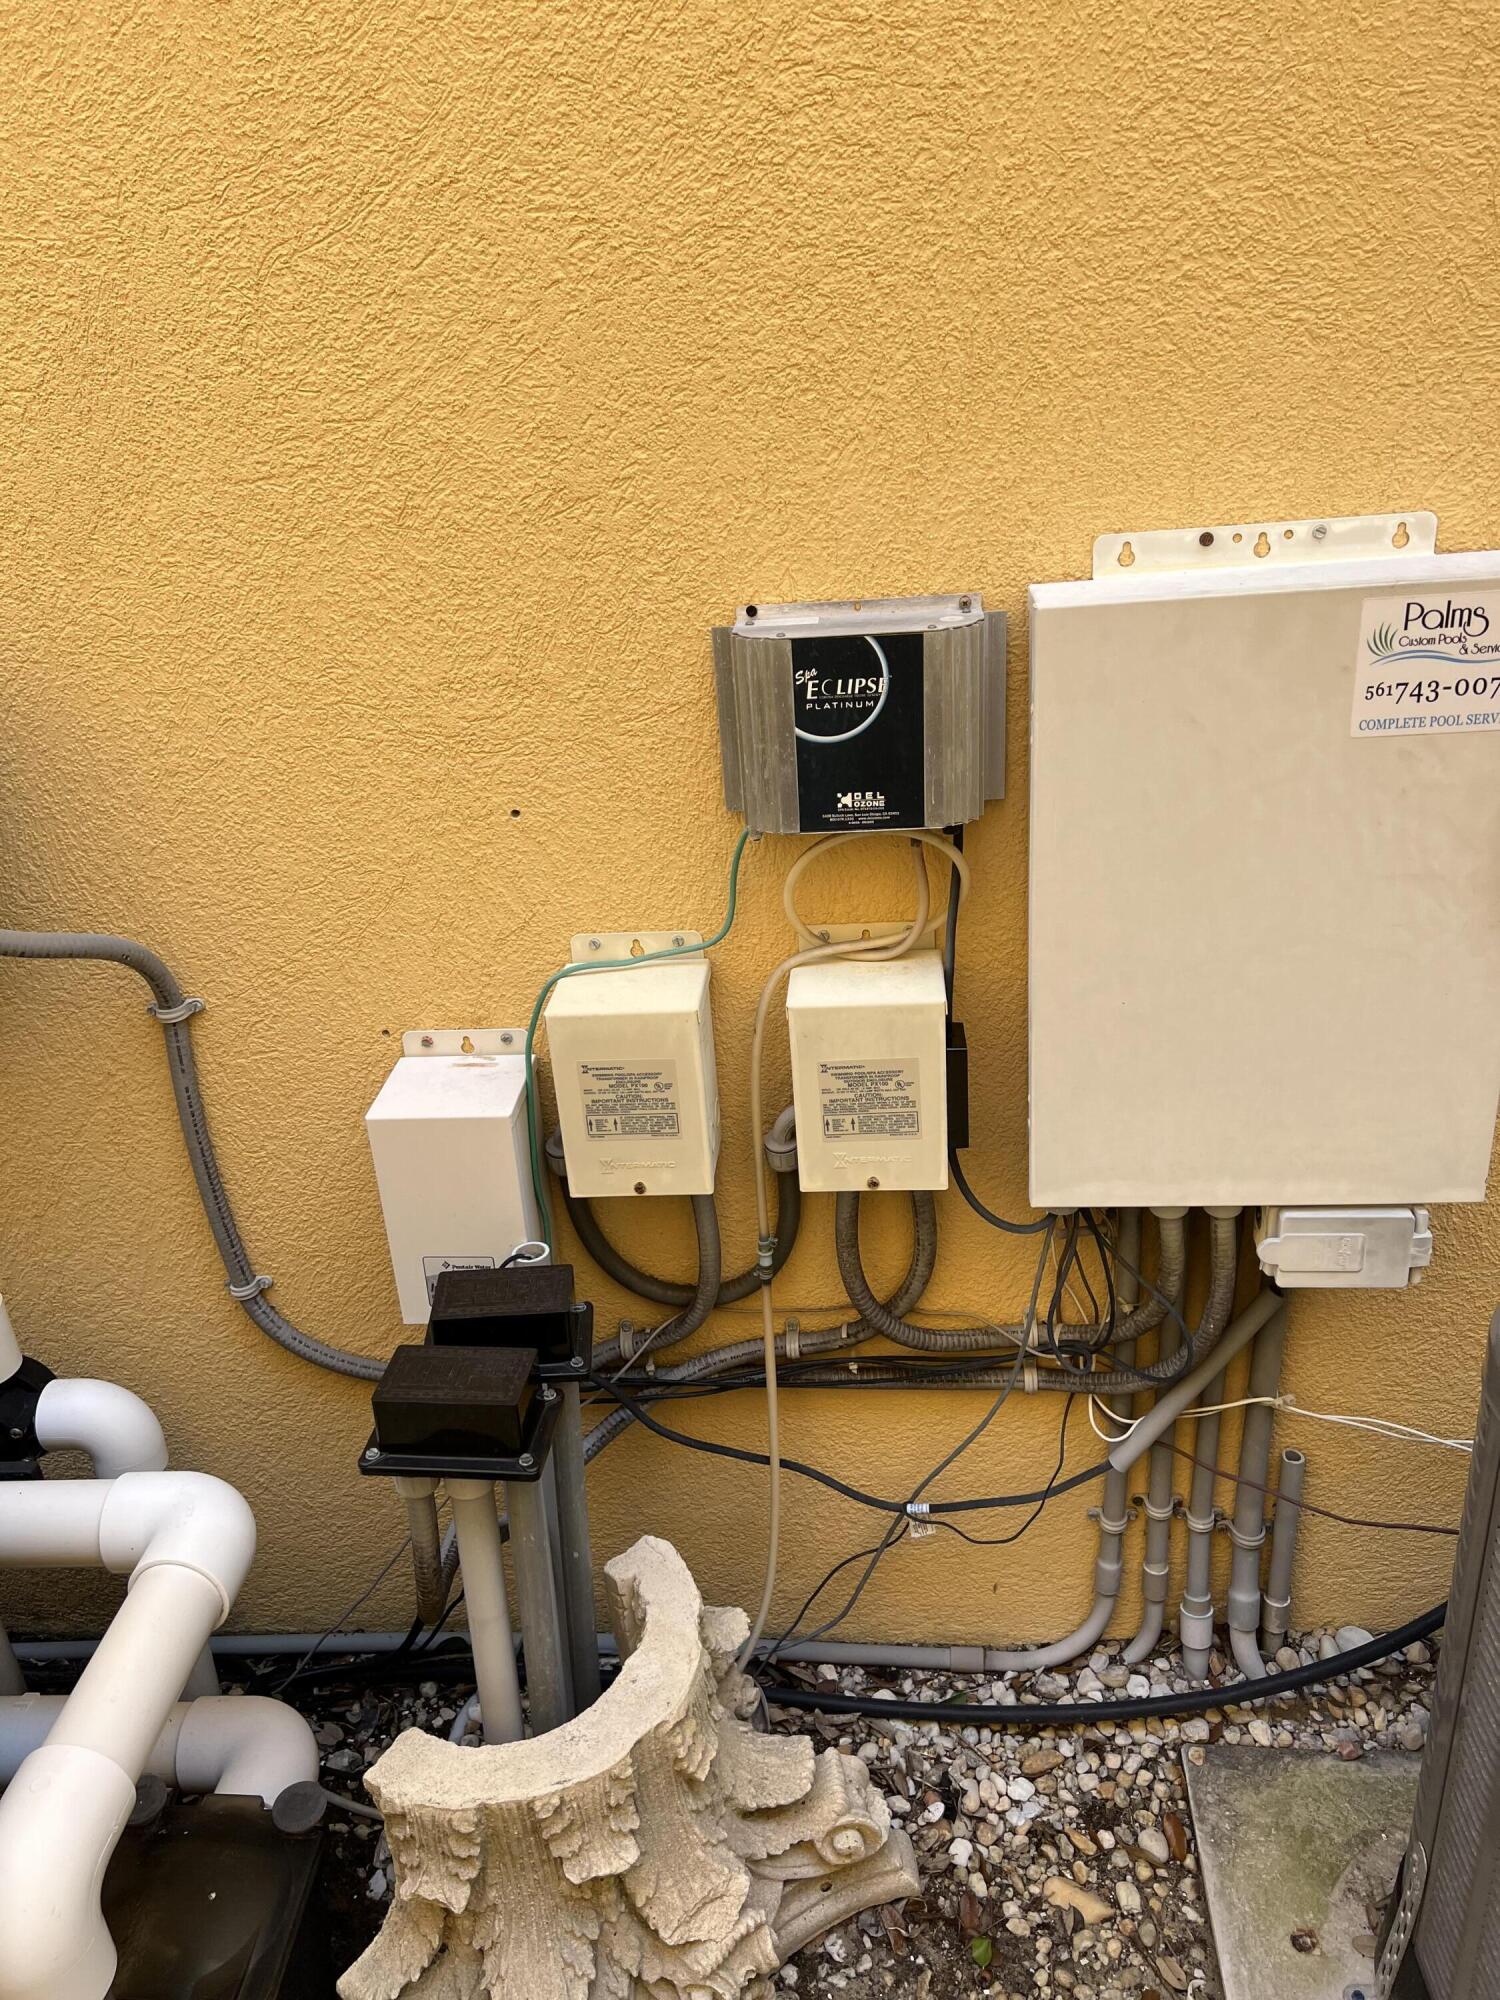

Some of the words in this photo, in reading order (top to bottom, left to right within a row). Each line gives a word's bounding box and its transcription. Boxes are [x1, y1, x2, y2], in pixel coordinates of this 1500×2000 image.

[1404, 600, 1489, 637] Palms
[1399, 636, 1436, 647] Custom
[1438, 633, 1467, 645] Pools
[1459, 643, 1468, 655] &
[795, 668, 818, 685] Spa
[806, 700, 874, 711] PLATINUM
[1359, 716, 1427, 731] COMPLETE
[1430, 714, 1464, 727] POOL
[854, 792, 885, 800] DEL
